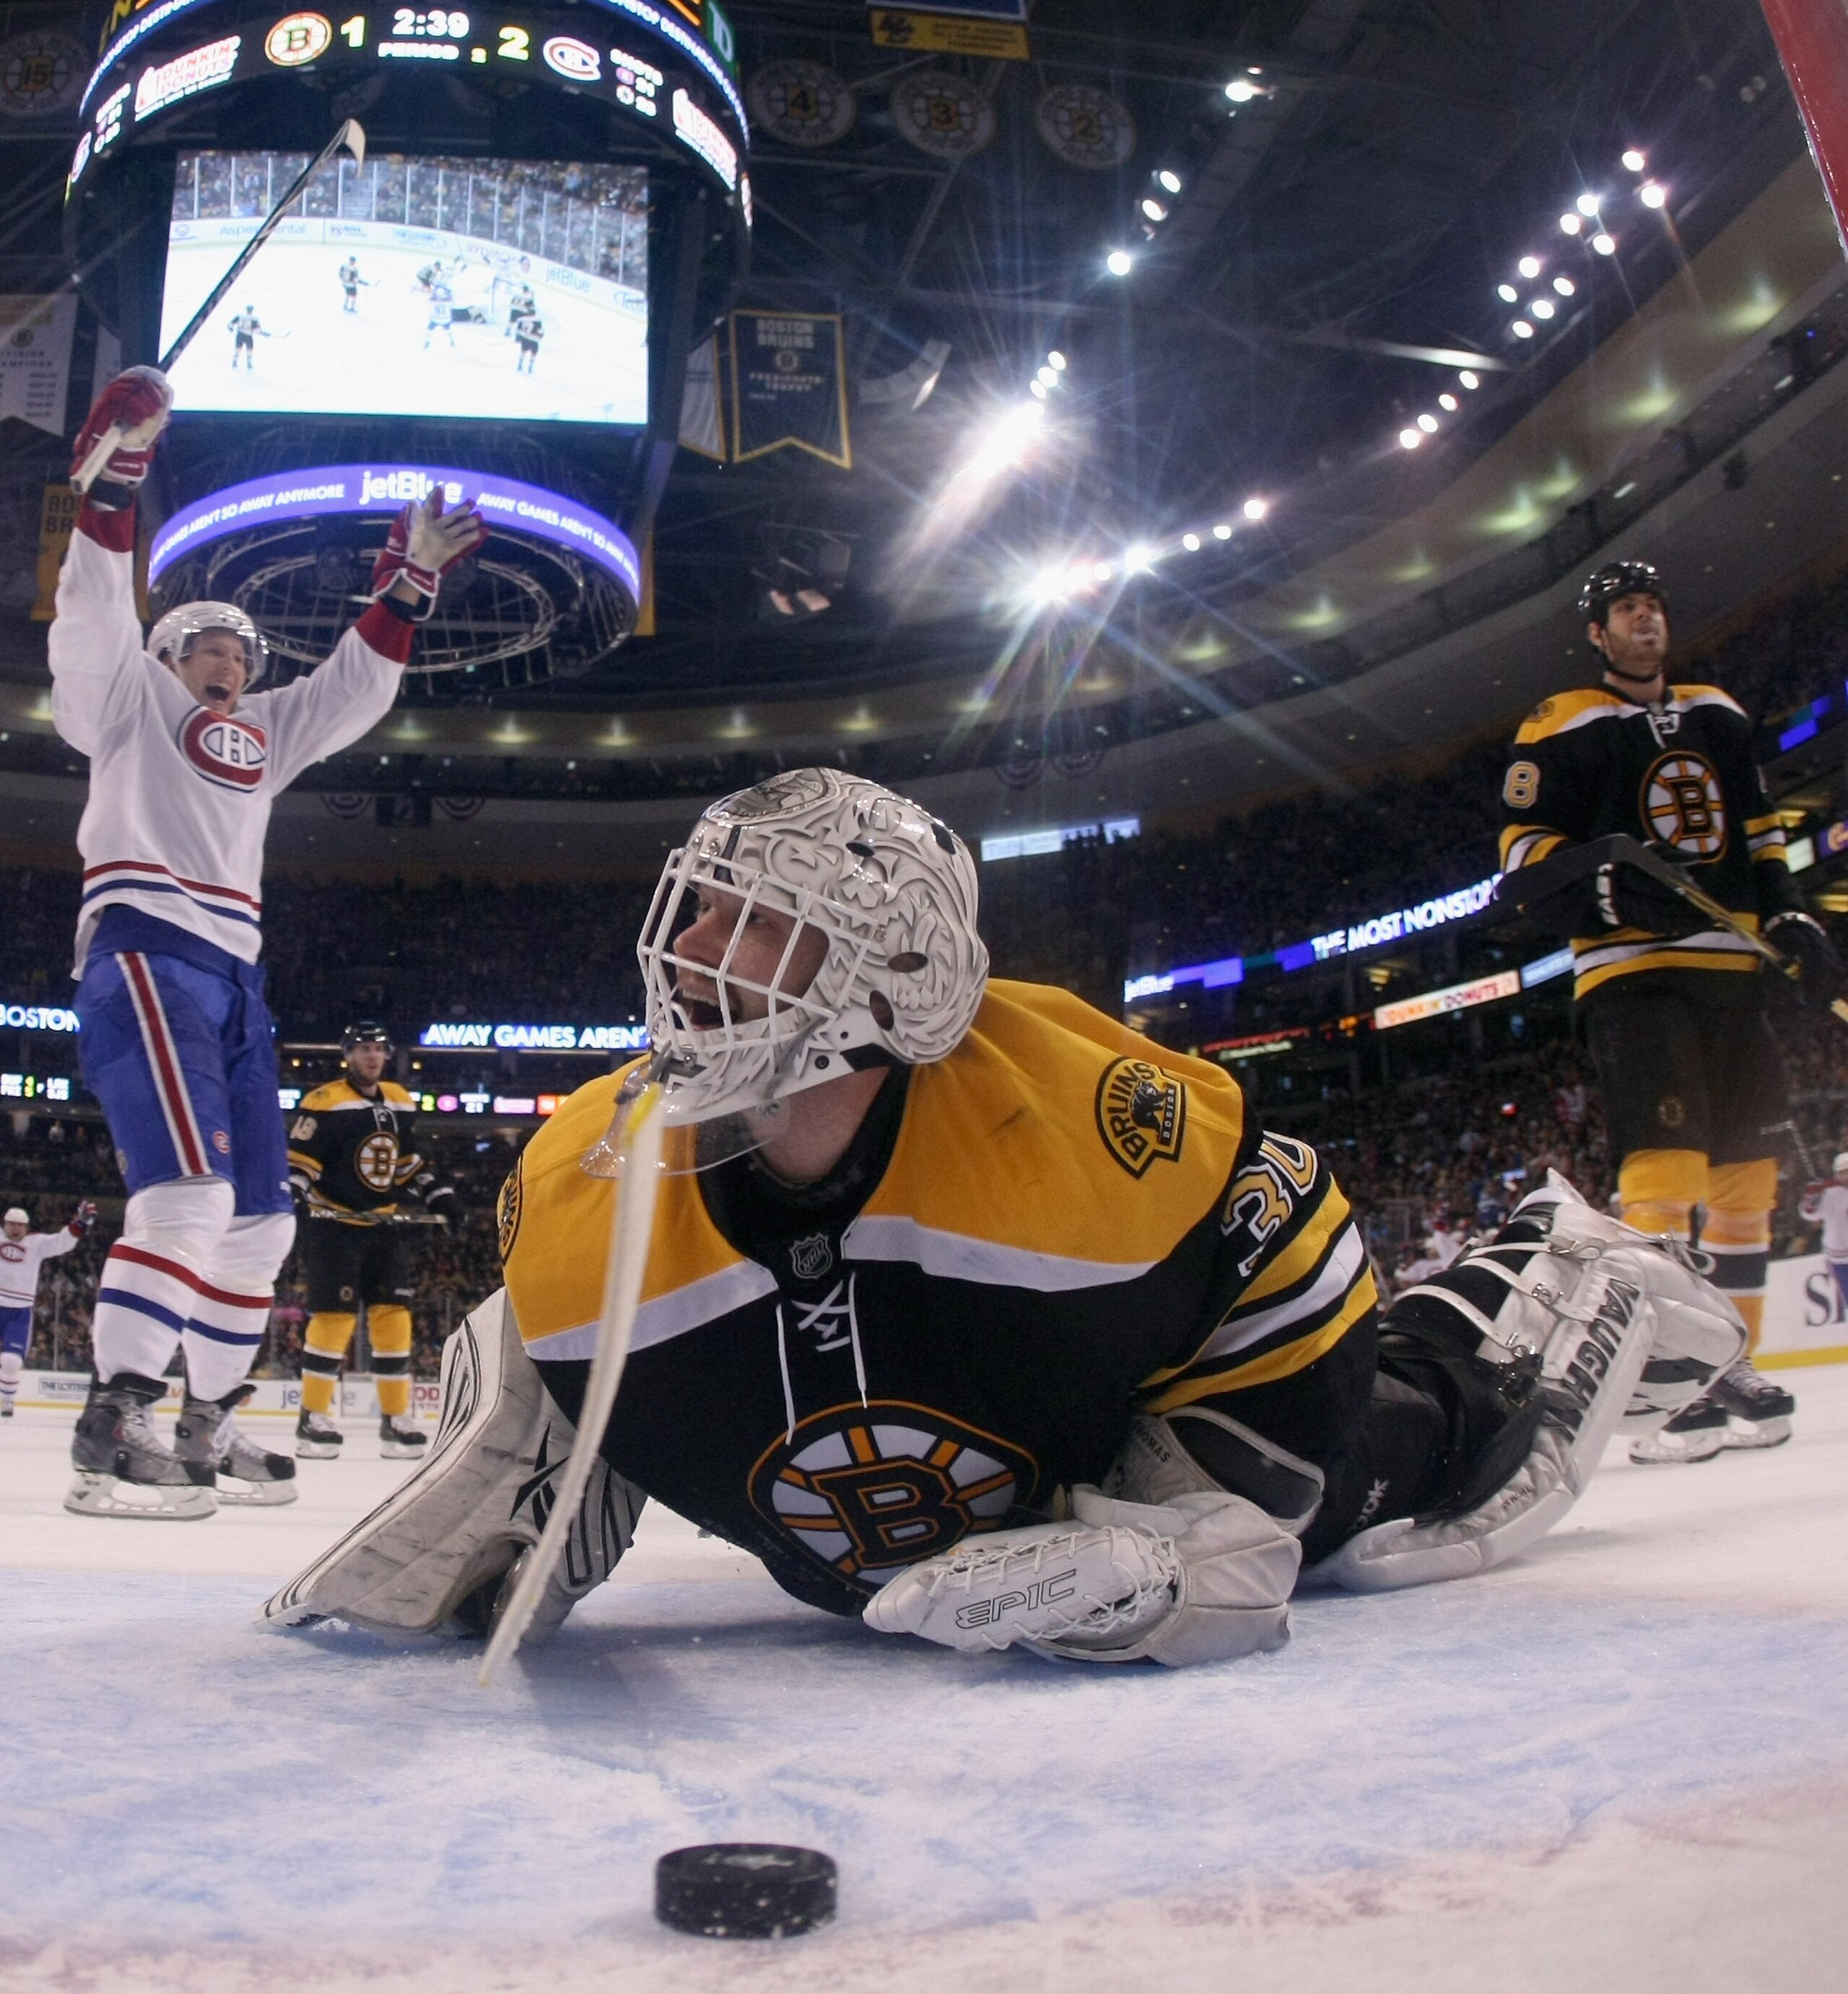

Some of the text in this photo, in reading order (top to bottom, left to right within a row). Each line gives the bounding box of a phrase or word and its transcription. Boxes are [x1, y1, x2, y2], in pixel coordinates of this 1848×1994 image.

[340, 15, 366, 48] 1
[392, 8, 470, 39] 2:39
[378, 41, 461, 61] PERIOD
[497, 26, 531, 62] 2
[221, 503, 238, 521] SO
[238, 494, 276, 515] AWAY
[274, 483, 346, 506] ANYMORE
[476, 492, 517, 512] AWAY
[516, 500, 560, 526] GAMES
[1502, 760, 1541, 809] 8
[1347, 912, 1403, 952] MOST
[1403, 879, 1493, 933] NONSTOP
[424, 1024, 492, 1047] AWAY
[494, 1025, 576, 1048] GAMES
[421, 1094, 435, 1113] 2
[1107, 1062, 1156, 1162] BRUINS
[1162, 1087, 1176, 1139] BOSTON
[954, 1567, 1077, 1629] EPIC
